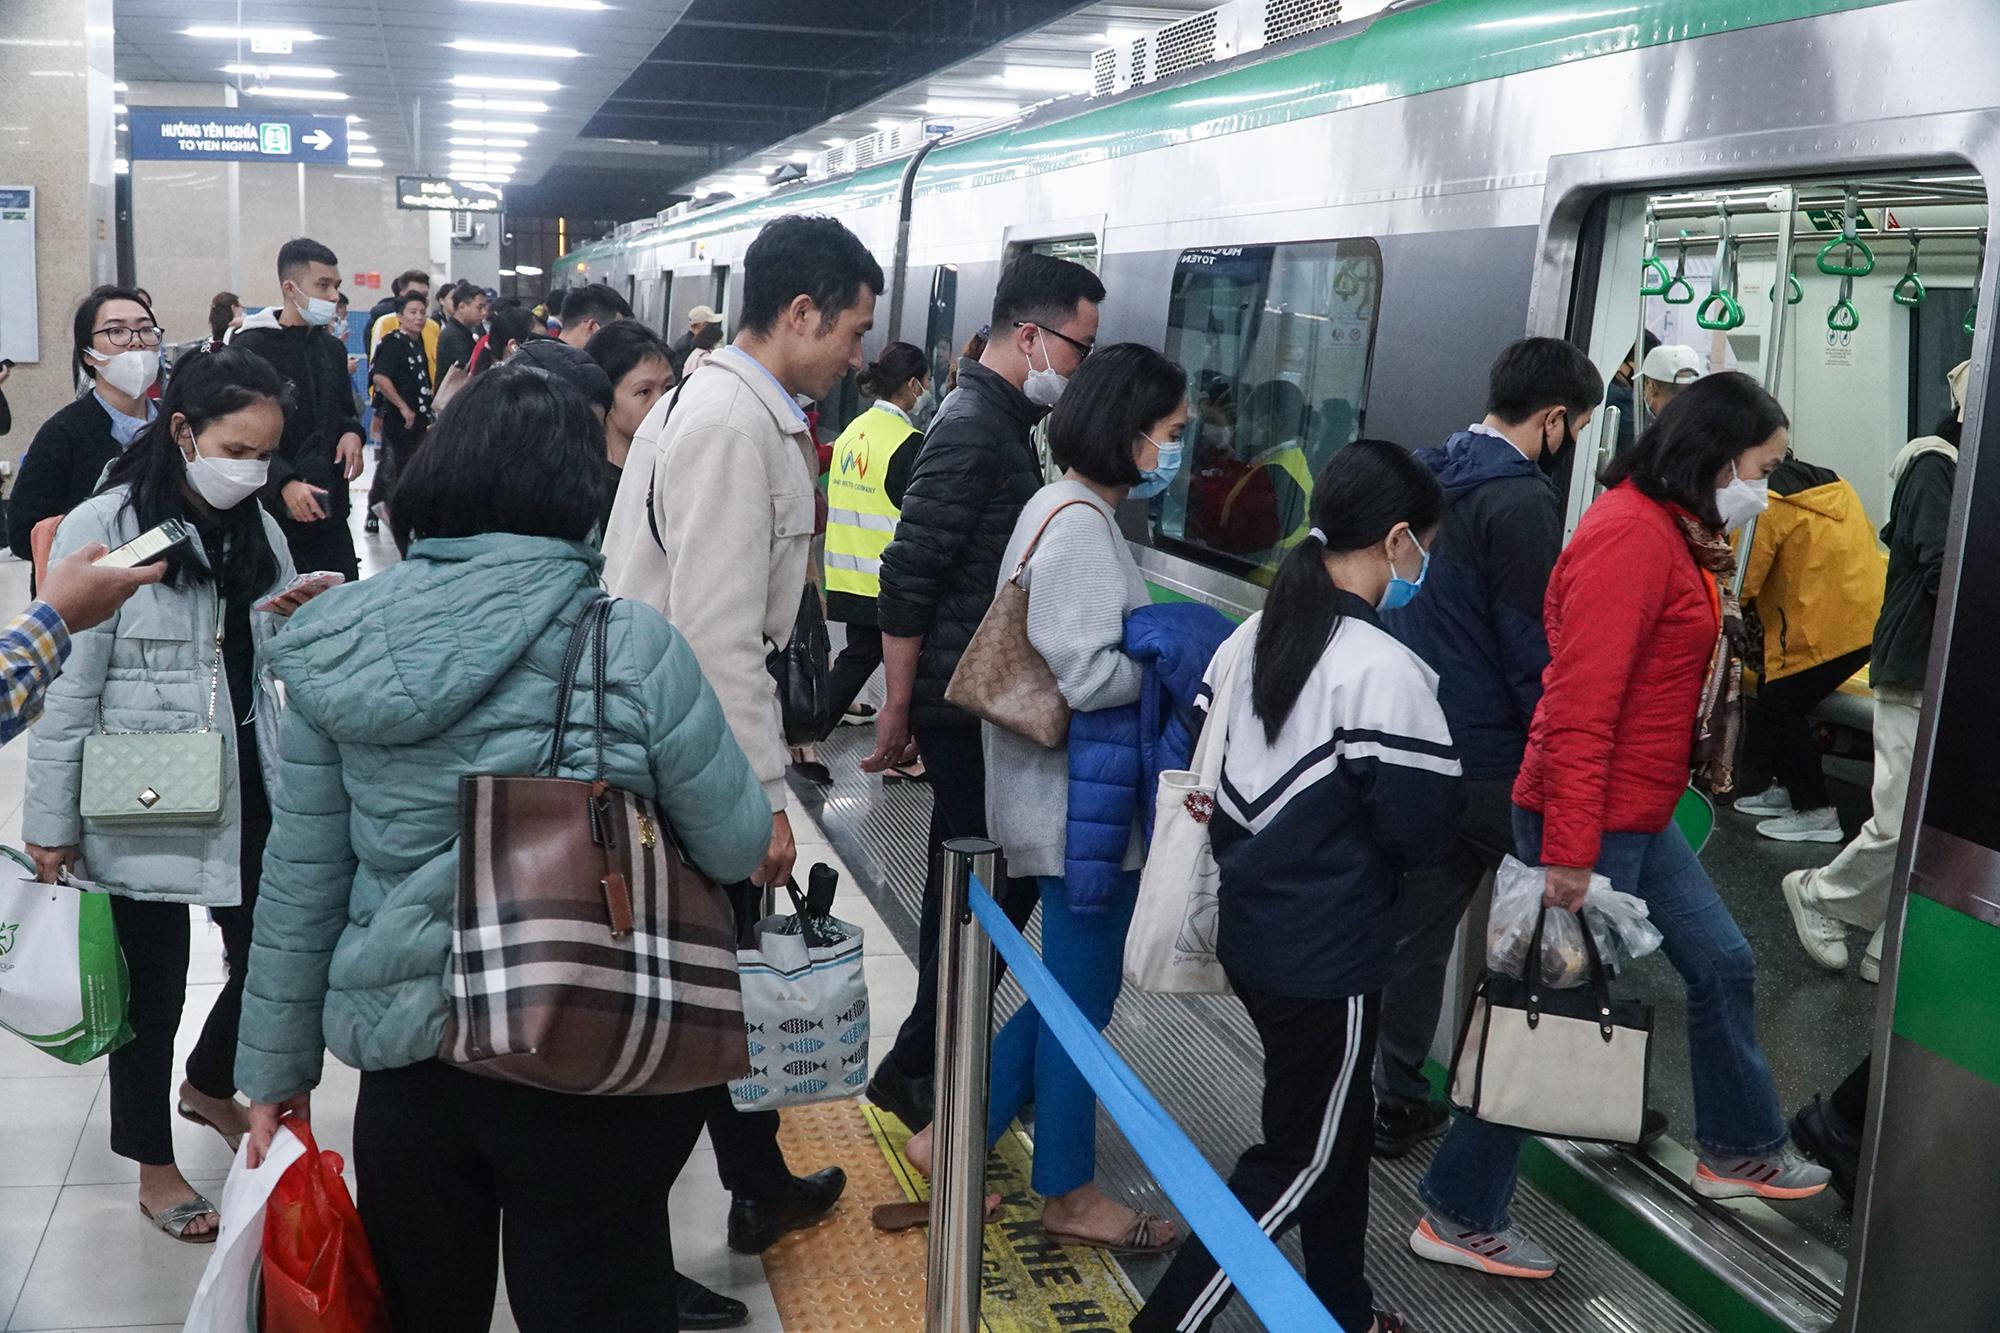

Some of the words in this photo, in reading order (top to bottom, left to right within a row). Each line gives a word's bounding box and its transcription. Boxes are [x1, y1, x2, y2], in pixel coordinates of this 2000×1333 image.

[201, 121, 224, 139] YÊN
[178, 140, 195, 151] TO
[196, 140, 220, 152] YEN
[221, 141, 259, 152] NGHIA
[1049, 1300, 1116, 1333] H
